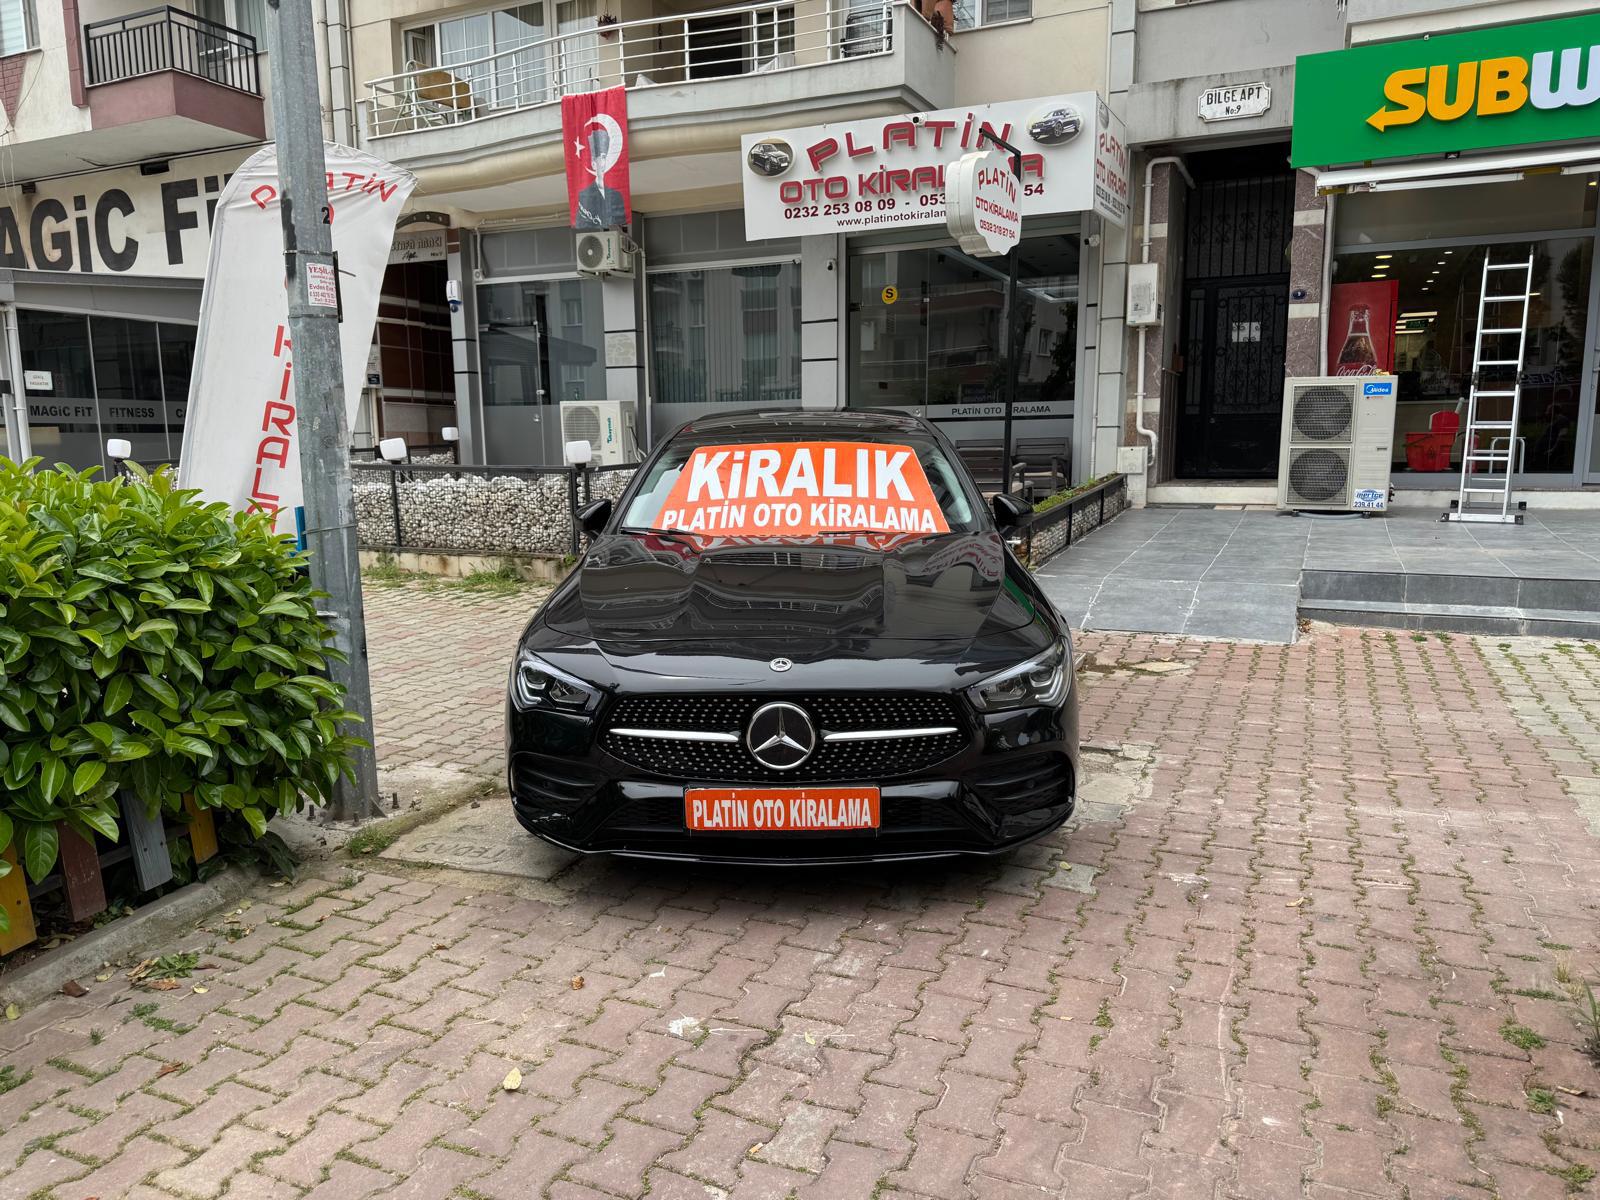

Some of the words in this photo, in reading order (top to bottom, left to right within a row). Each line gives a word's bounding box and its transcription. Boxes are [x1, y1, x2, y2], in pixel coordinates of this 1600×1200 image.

[1206, 90, 1238, 106] BİLGE
[1240, 86, 1262, 102] APT
[806, 112, 1013, 173] PLATİN
[779, 175, 850, 205] OTO
[783, 206, 819, 220] 0232
[824, 203, 850, 216] 253
[855, 200, 873, 213] 08
[878, 198, 896, 211] 09
[1023, 183, 1045, 197] 54
[977, 167, 1017, 204] PLATİN
[984, 406, 1002, 415] OTO
[661, 500, 746, 531] PLATİN
[752, 503, 802, 527] OTO
[809, 498, 938, 534] KİRALAMA
[692, 792, 749, 828] PLATİN
[752, 798, 785, 828] OTO
[789, 792, 872, 828] KİRALAMA
